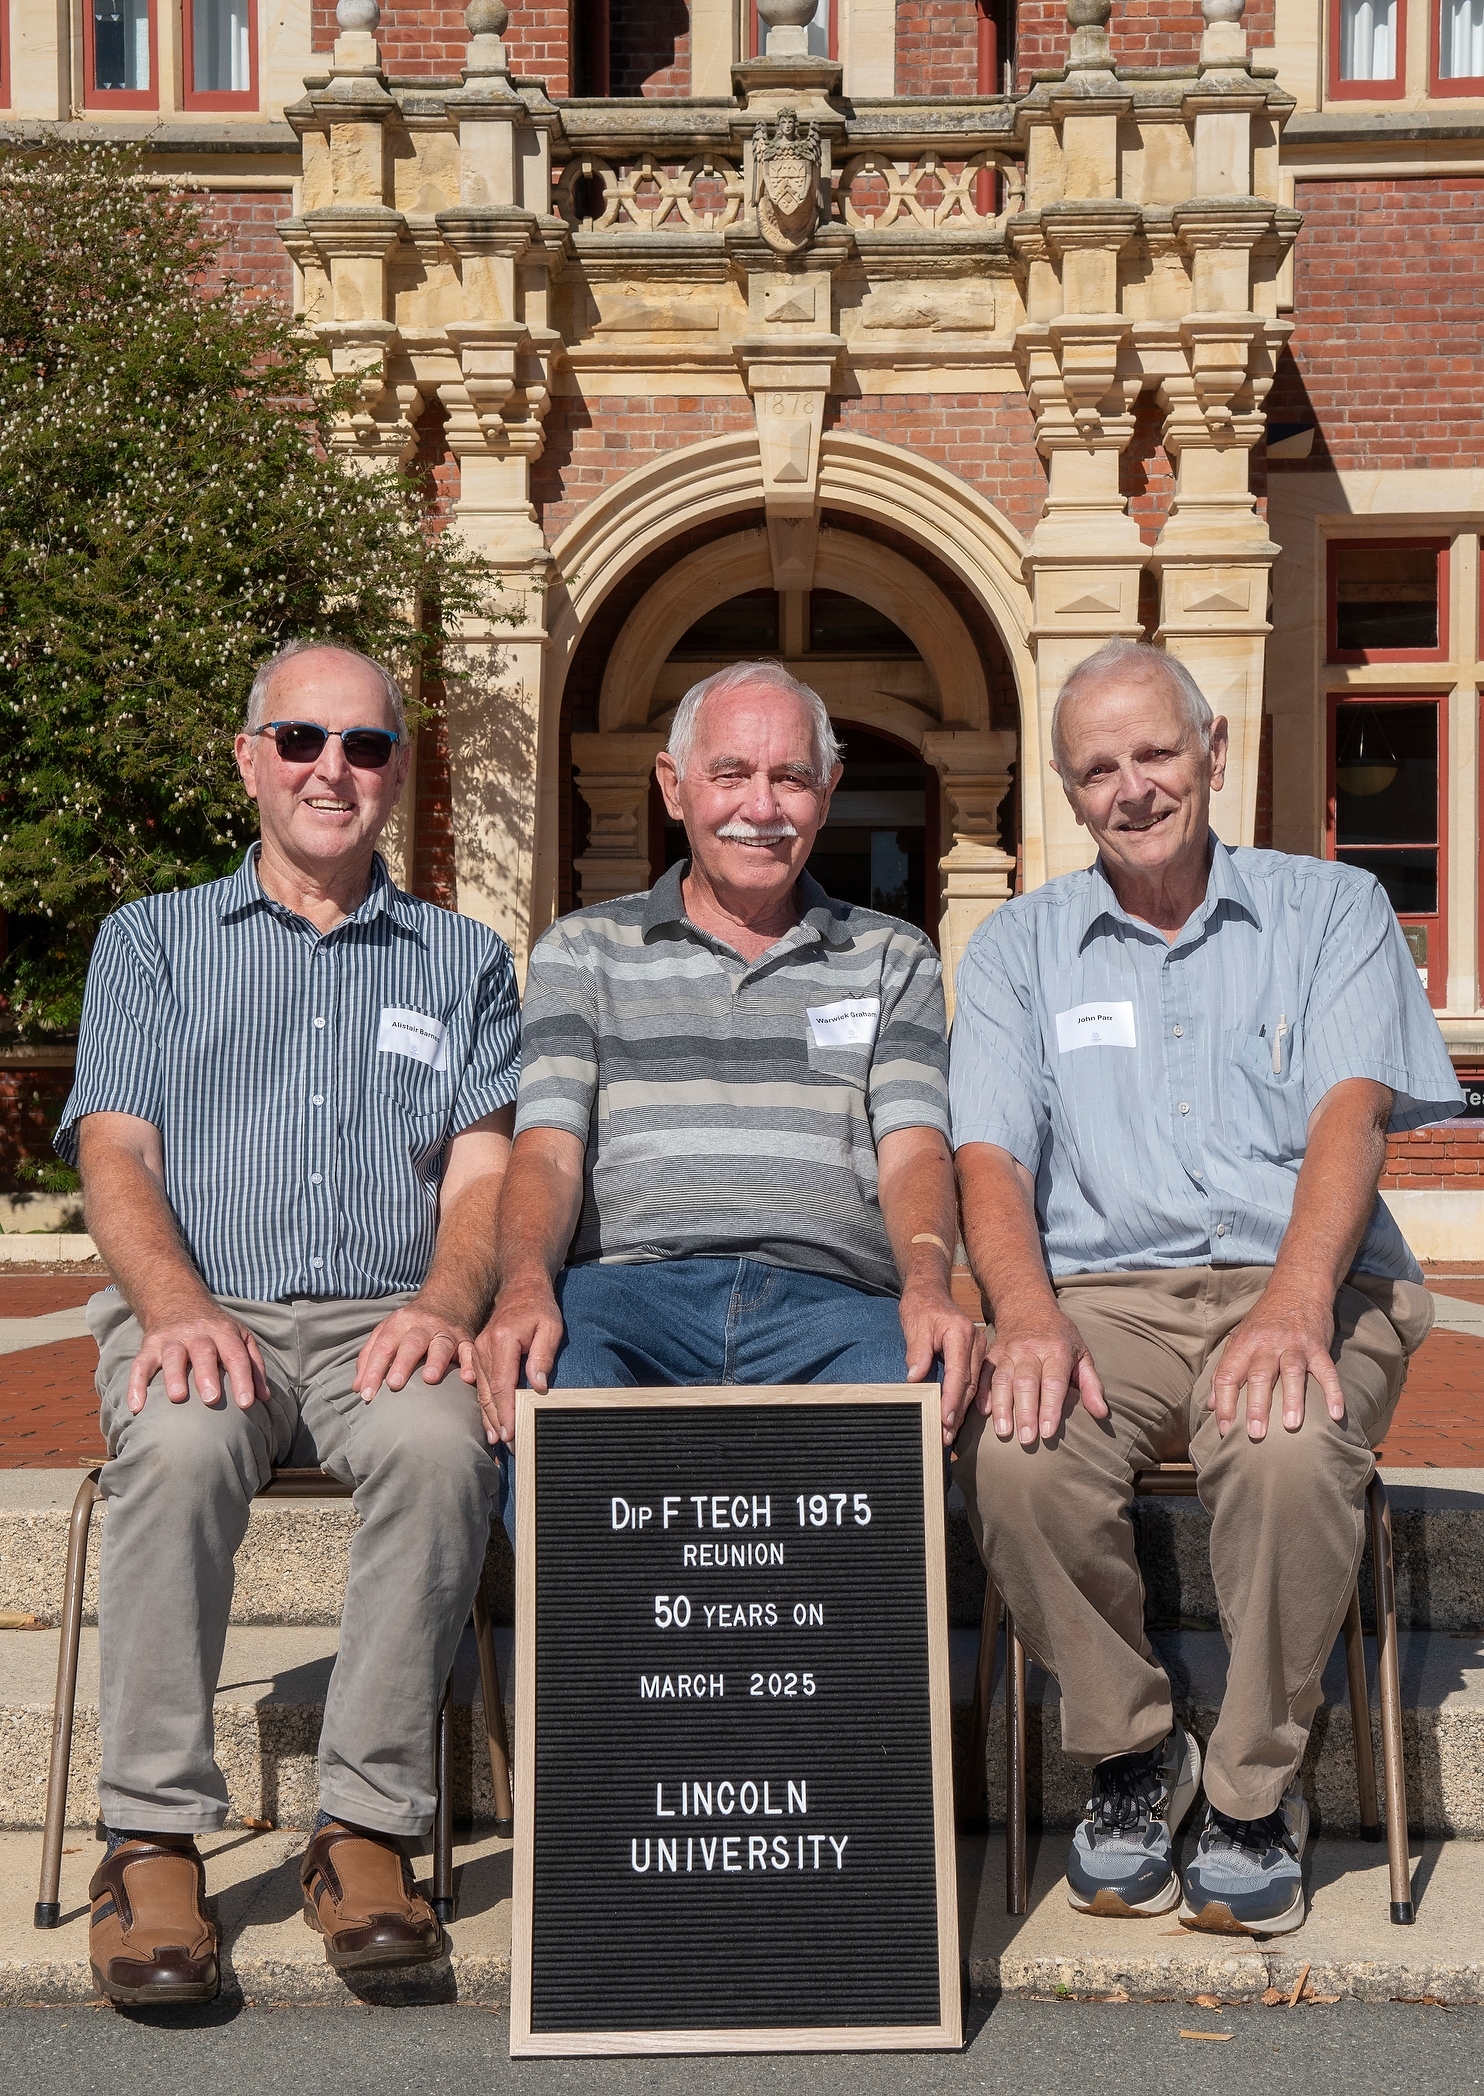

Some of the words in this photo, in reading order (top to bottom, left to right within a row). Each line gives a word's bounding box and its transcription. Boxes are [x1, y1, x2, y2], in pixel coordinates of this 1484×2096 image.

[764, 393, 815, 415] 1878
[391, 1021, 419, 1033] Alistair
[816, 1013, 850, 1024] Warwick
[850, 1011, 878, 1019] Graham
[1077, 1016, 1096, 1024] John
[663, 1496, 681, 1529] F
[690, 1495, 771, 1528] TECH
[796, 1493, 872, 1526] 1975
[683, 1543, 784, 1567] REUNION
[654, 1595, 691, 1628] 50
[703, 1603, 778, 1628] YEARS
[793, 1603, 824, 1626] ON
[640, 1673, 724, 1698] MARCH
[750, 1673, 816, 1696] 2025
[656, 1780, 807, 1816] LINCOLN
[632, 1835, 848, 1873] UNIVERSITY
